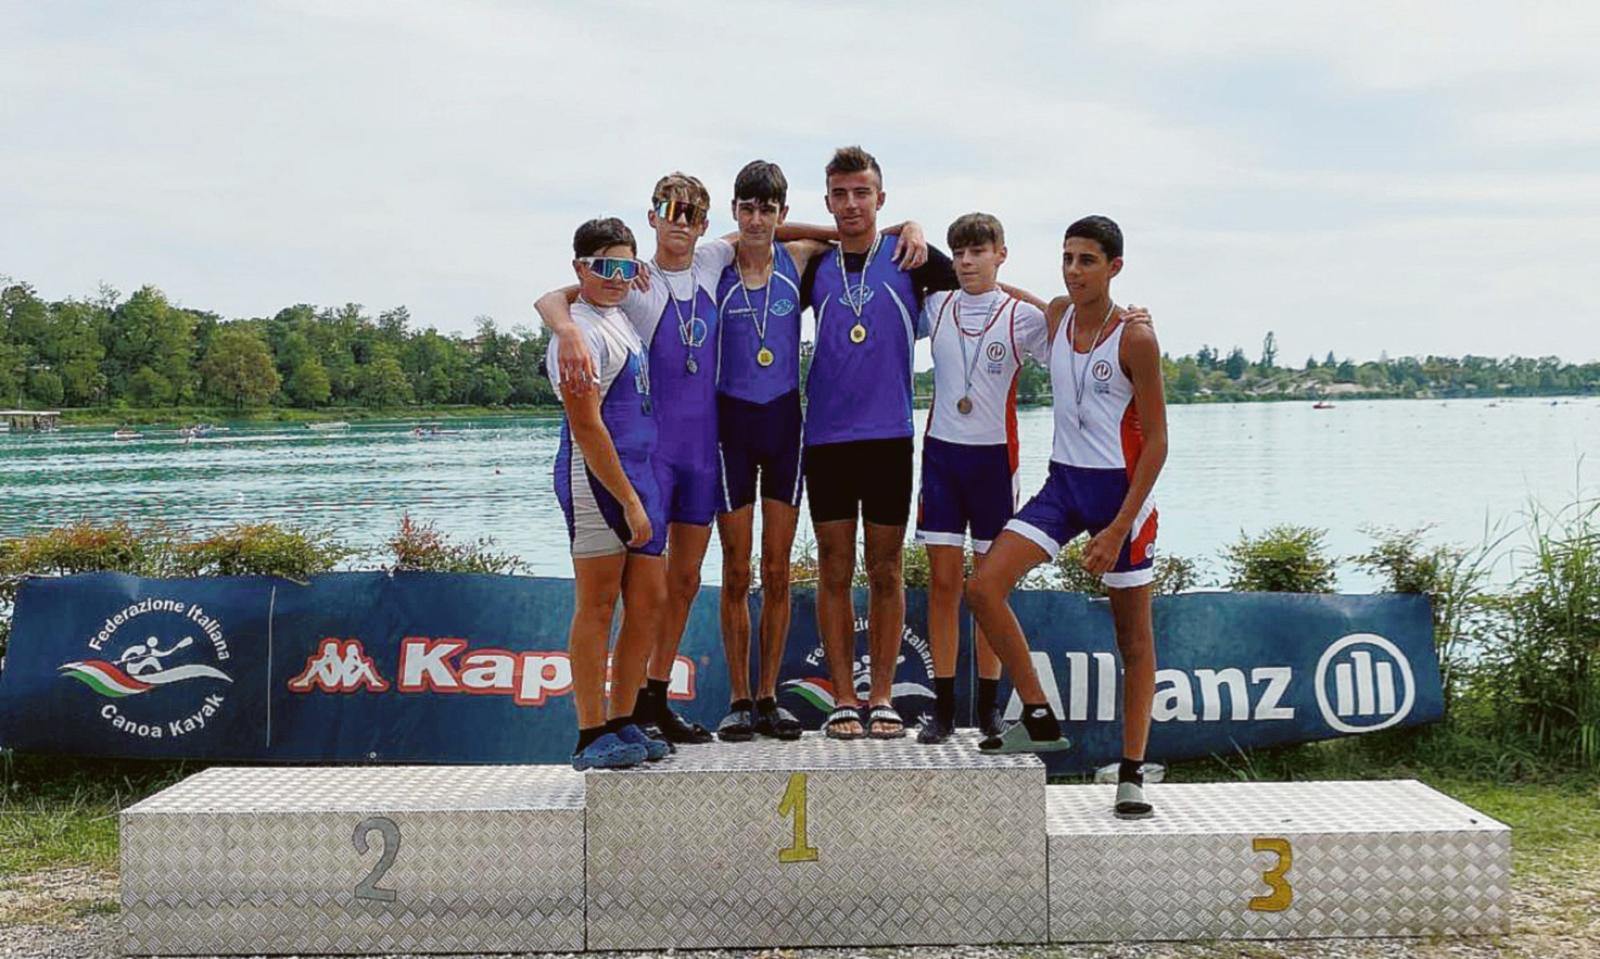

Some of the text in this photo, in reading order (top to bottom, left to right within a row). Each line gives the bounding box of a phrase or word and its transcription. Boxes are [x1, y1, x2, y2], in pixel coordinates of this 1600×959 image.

[89, 598, 231, 661] Federazione Italiana
[902, 624, 936, 682] taliana
[400, 637, 696, 705] Kap
[1002, 651, 1296, 722] Allanz
[100, 692, 225, 739] Canoa Kayak
[777, 772, 819, 864] 1
[351, 816, 400, 902] 2
[1248, 838, 1293, 912] 3
